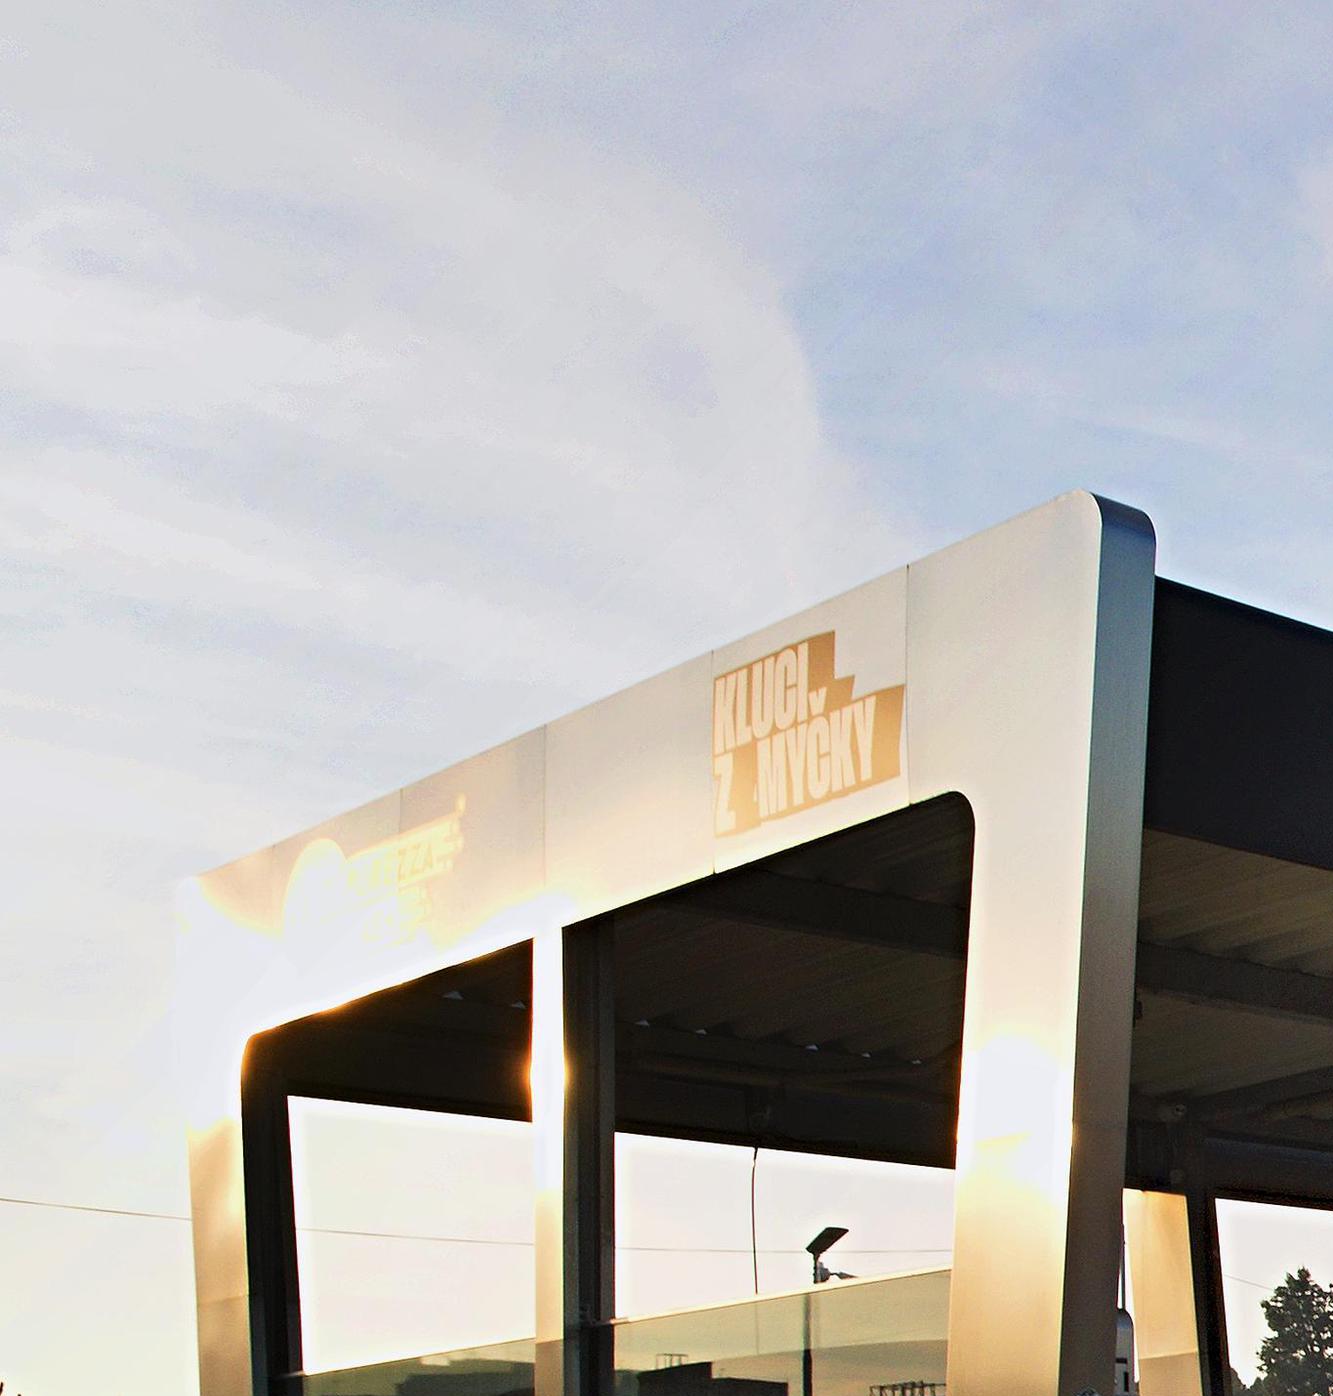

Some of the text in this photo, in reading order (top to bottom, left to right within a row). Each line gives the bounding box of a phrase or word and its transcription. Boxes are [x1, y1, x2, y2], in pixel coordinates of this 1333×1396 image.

[714, 641, 809, 757] KLUCI
[714, 686, 876, 836] Z MYČKY
